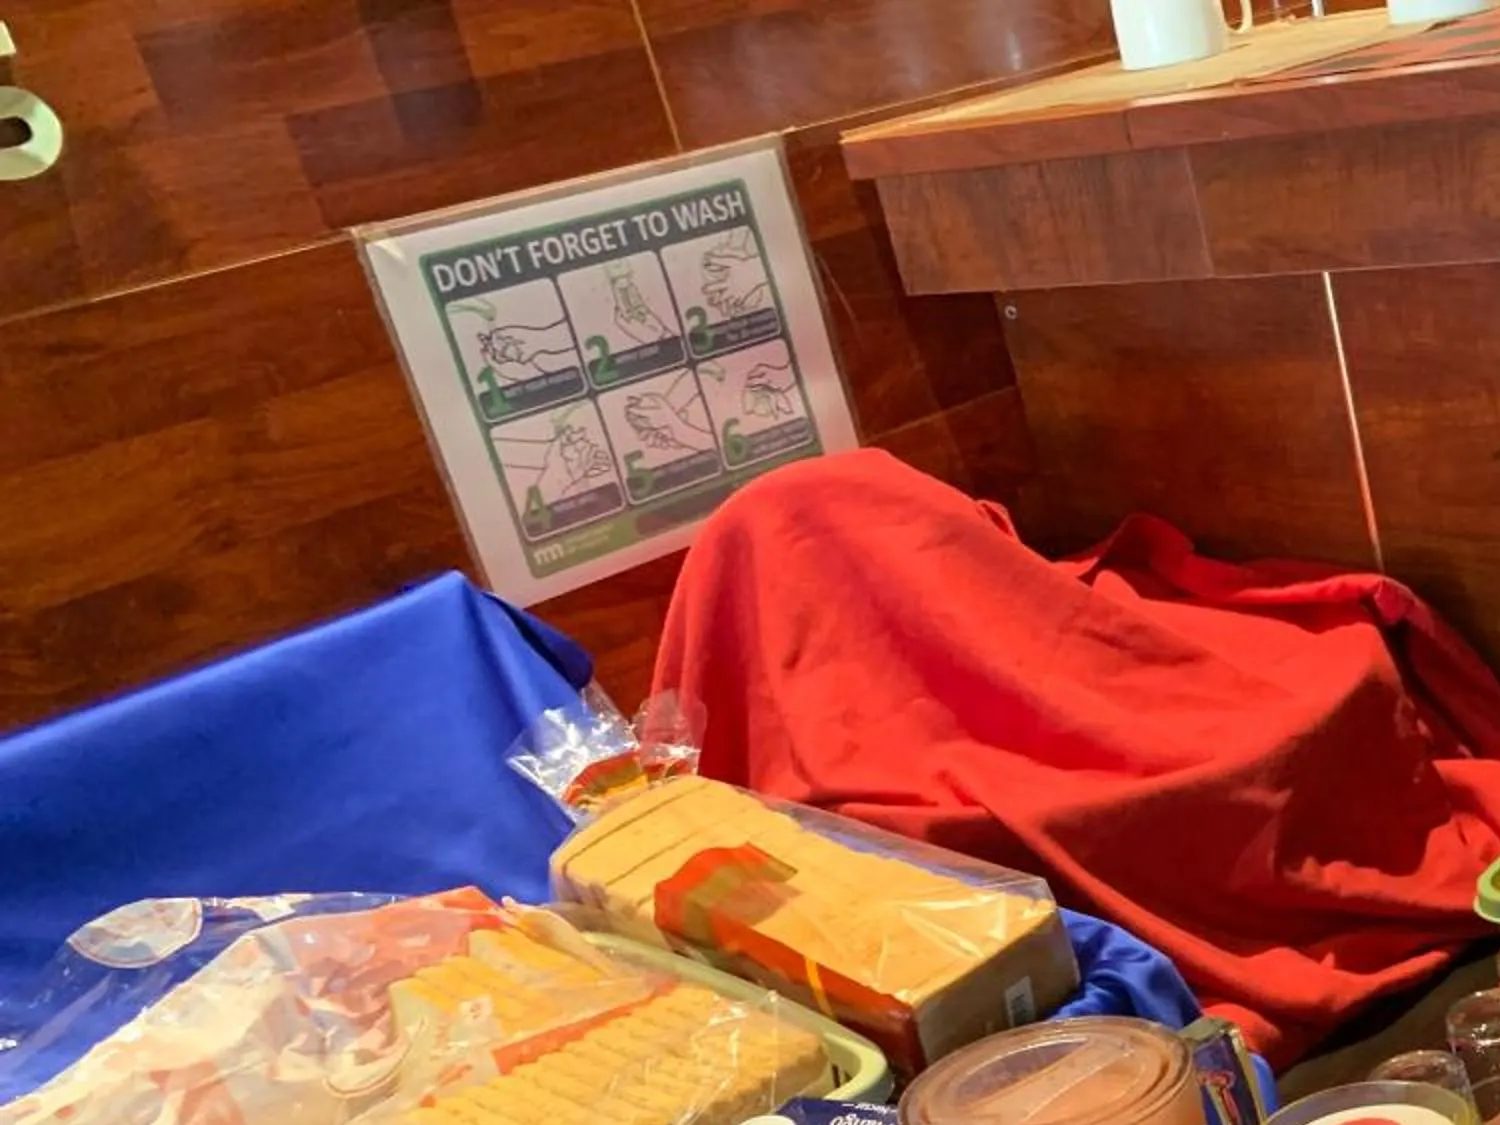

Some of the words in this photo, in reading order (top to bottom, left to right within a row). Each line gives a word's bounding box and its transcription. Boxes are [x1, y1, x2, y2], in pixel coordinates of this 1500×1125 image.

[432, 246, 522, 293] DON'T
[527, 220, 629, 270] FORGET
[633, 211, 669, 241] TO
[671, 190, 747, 232] WASH
[585, 335, 619, 384] 2
[477, 365, 514, 414] 1
[722, 417, 750, 465] 6
[624, 450, 653, 498] 5
[522, 484, 553, 531] 4
